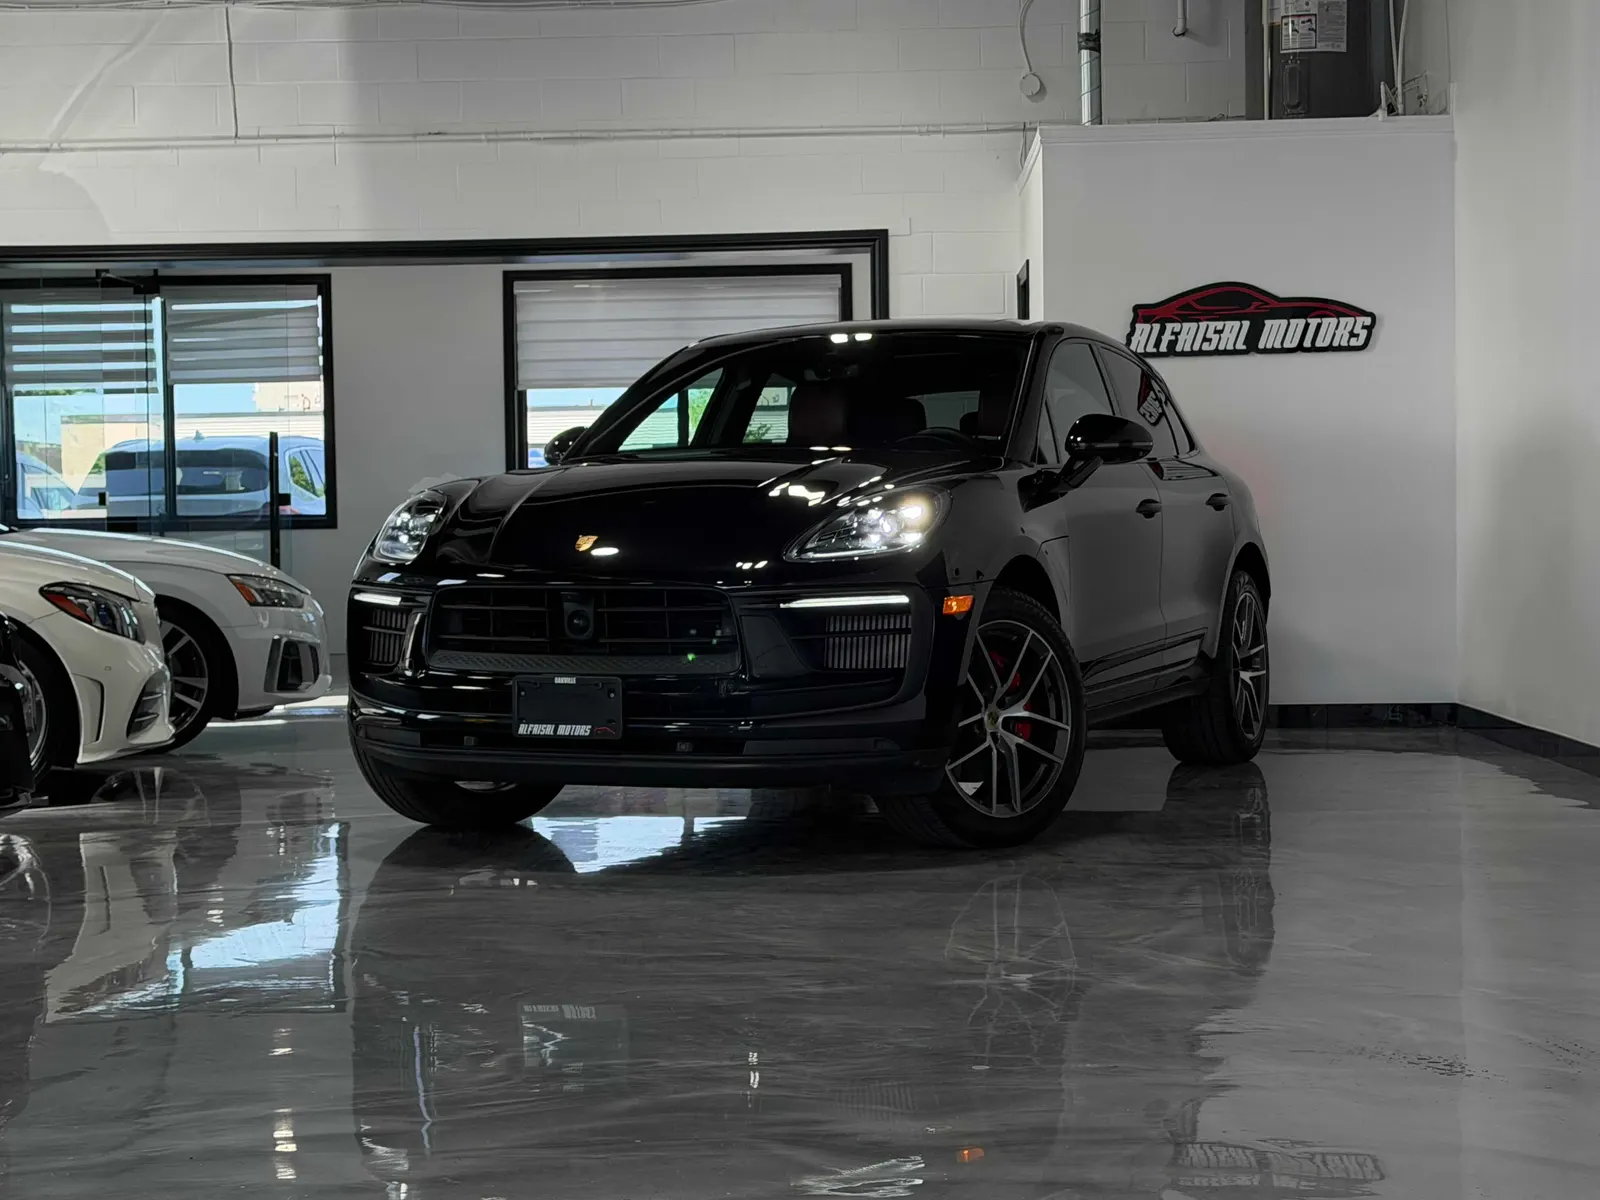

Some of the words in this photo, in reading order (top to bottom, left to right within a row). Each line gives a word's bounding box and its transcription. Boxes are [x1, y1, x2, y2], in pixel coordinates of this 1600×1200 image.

[1130, 321, 1250, 353] ALFAISAL
[1258, 317, 1371, 349] MOTORS
[518, 724, 555, 735] ALFAISAL
[557, 725, 592, 736] MOTORS
